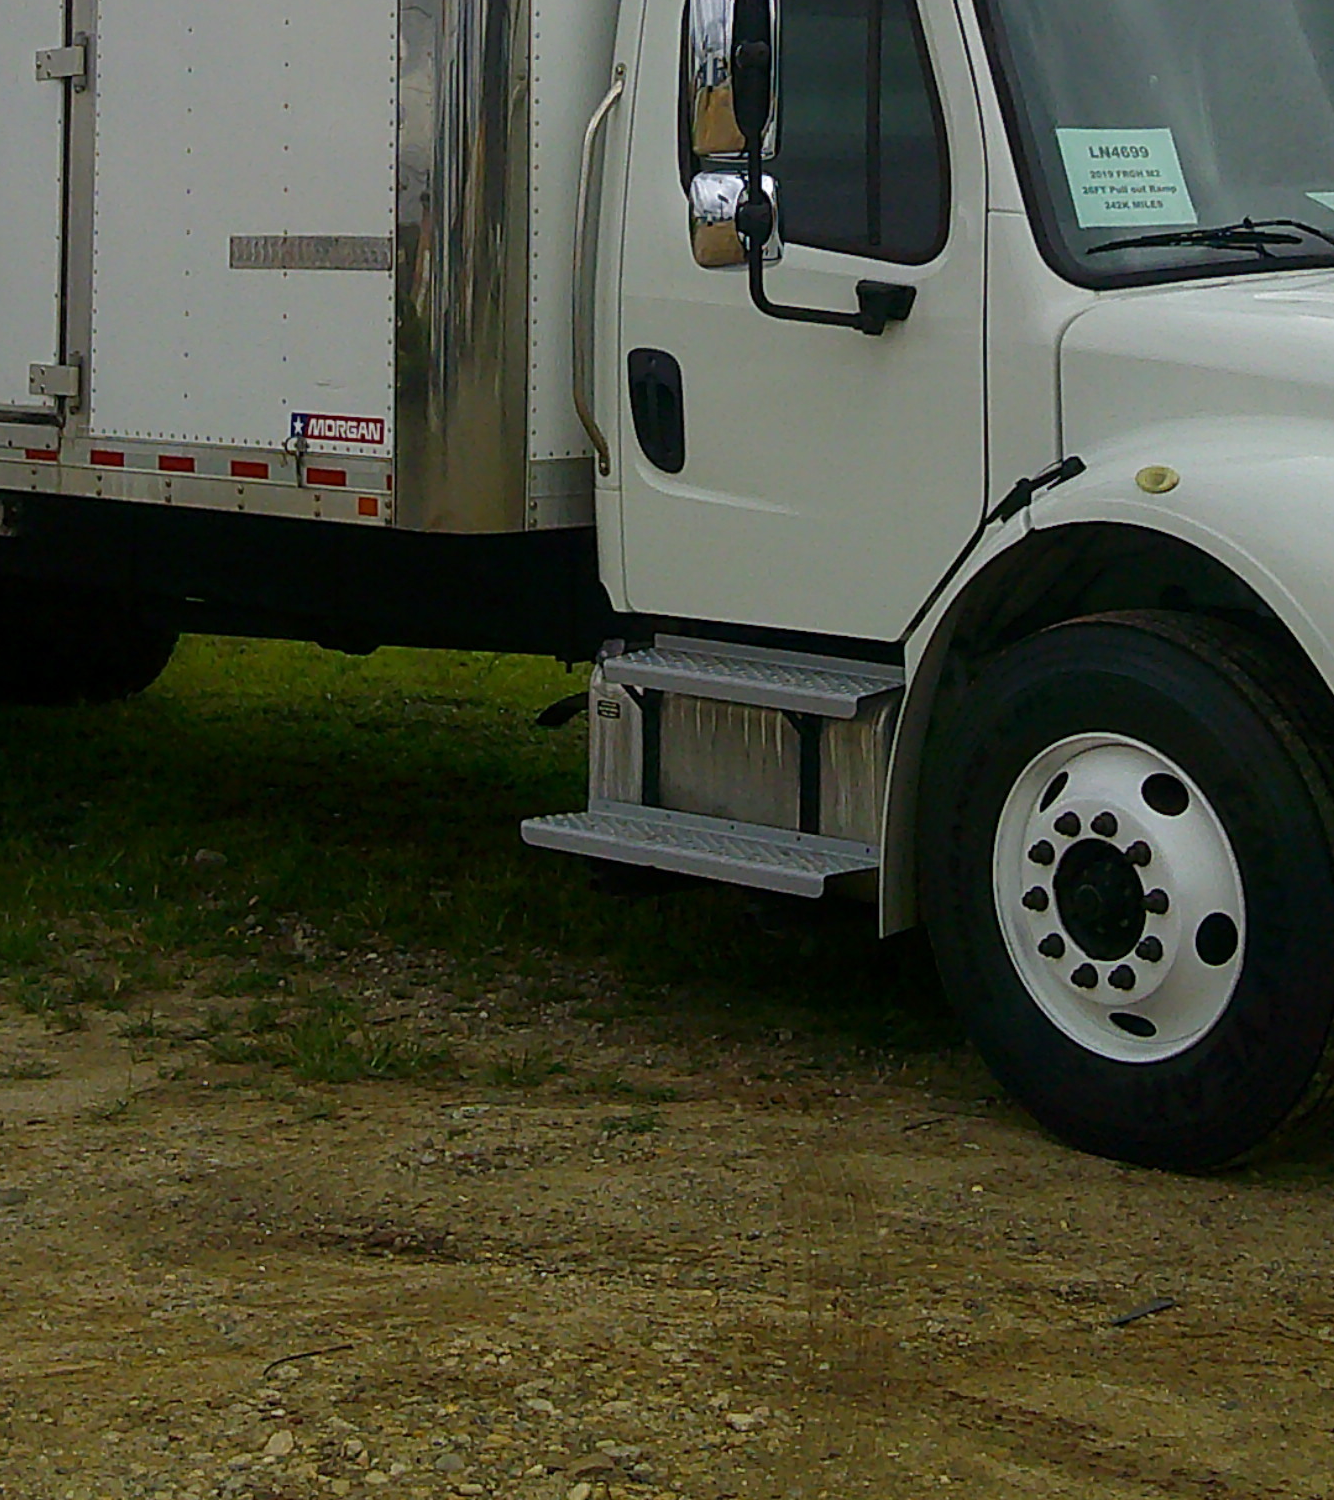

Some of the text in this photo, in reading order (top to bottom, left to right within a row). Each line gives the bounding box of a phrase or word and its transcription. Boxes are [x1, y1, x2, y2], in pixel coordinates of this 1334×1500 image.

[1088, 145, 1150, 159] LN4699
[1109, 185, 1128, 194] Pull
[1130, 185, 1147, 194] out
[1132, 200, 1164, 209] MILES
[307, 417, 381, 441] MORGAN
